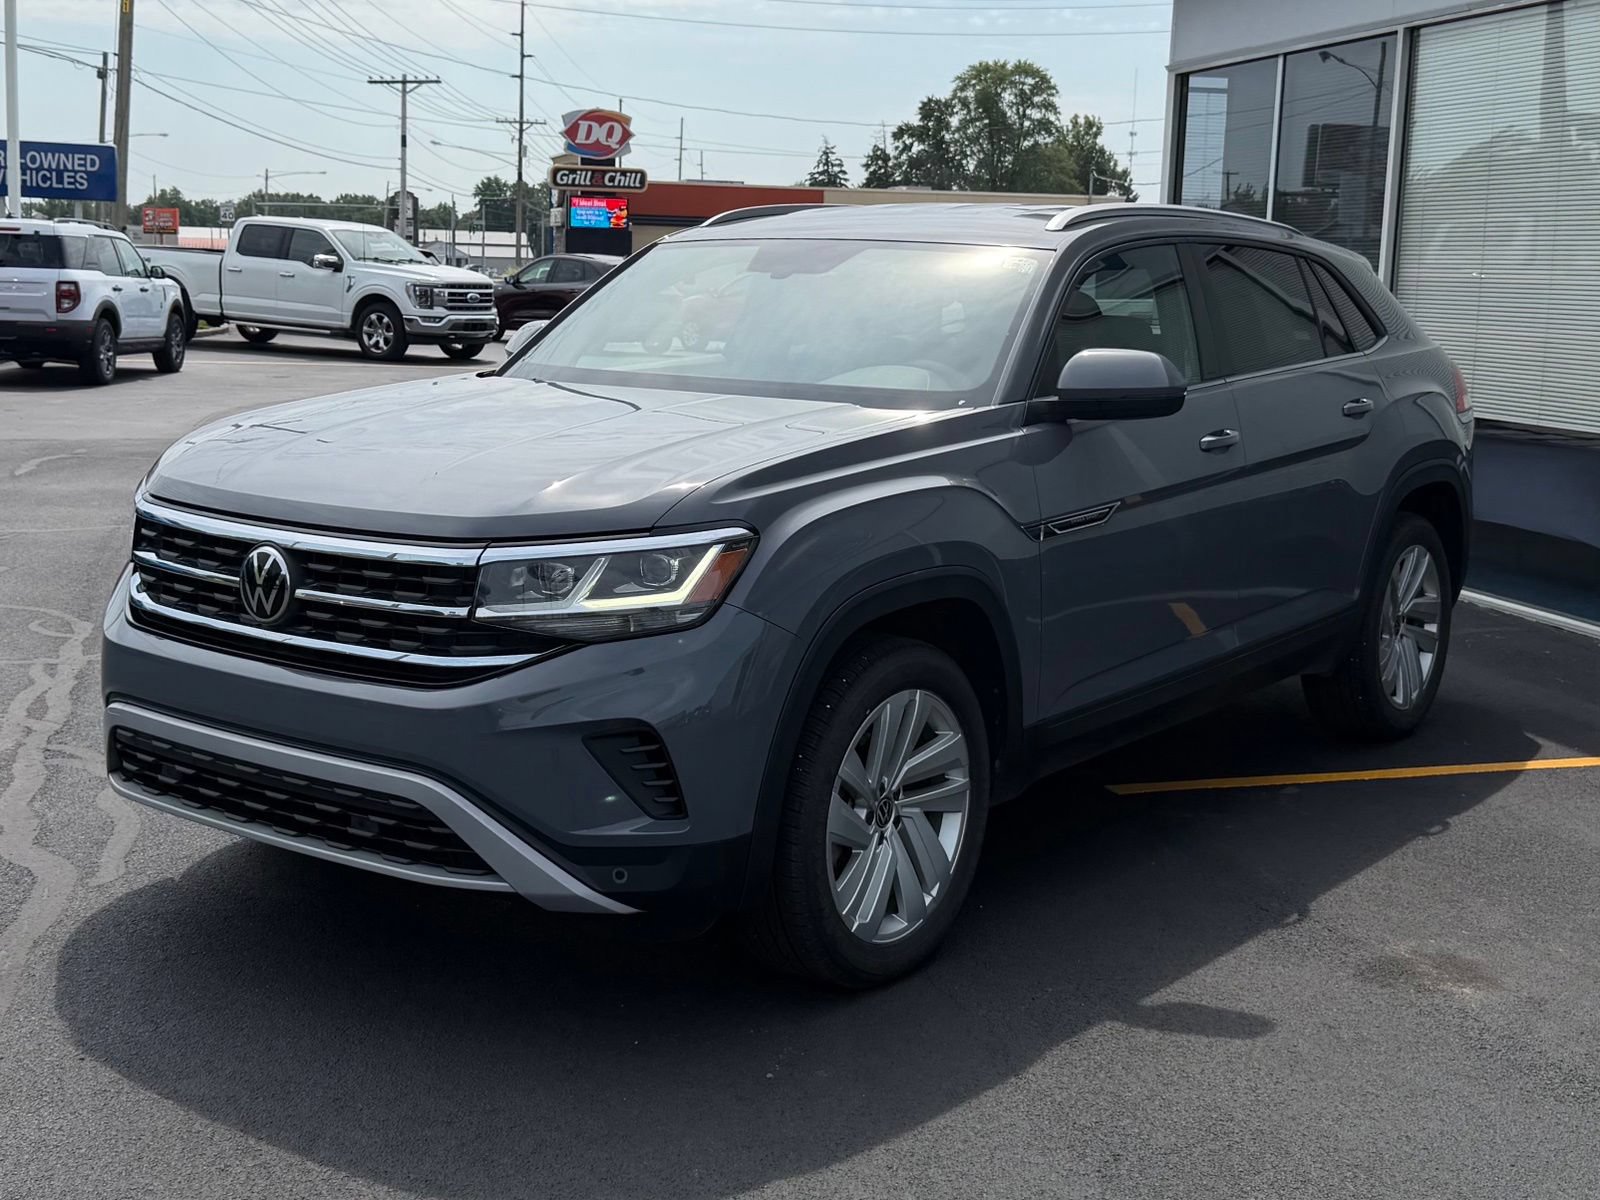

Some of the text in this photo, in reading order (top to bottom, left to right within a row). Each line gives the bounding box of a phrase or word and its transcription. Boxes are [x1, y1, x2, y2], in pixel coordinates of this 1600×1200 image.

[575, 120, 623, 149] DQ
[556, 170, 592, 185] Grill
[604, 171, 642, 187] Chill
[221, 212, 234, 220] 40
